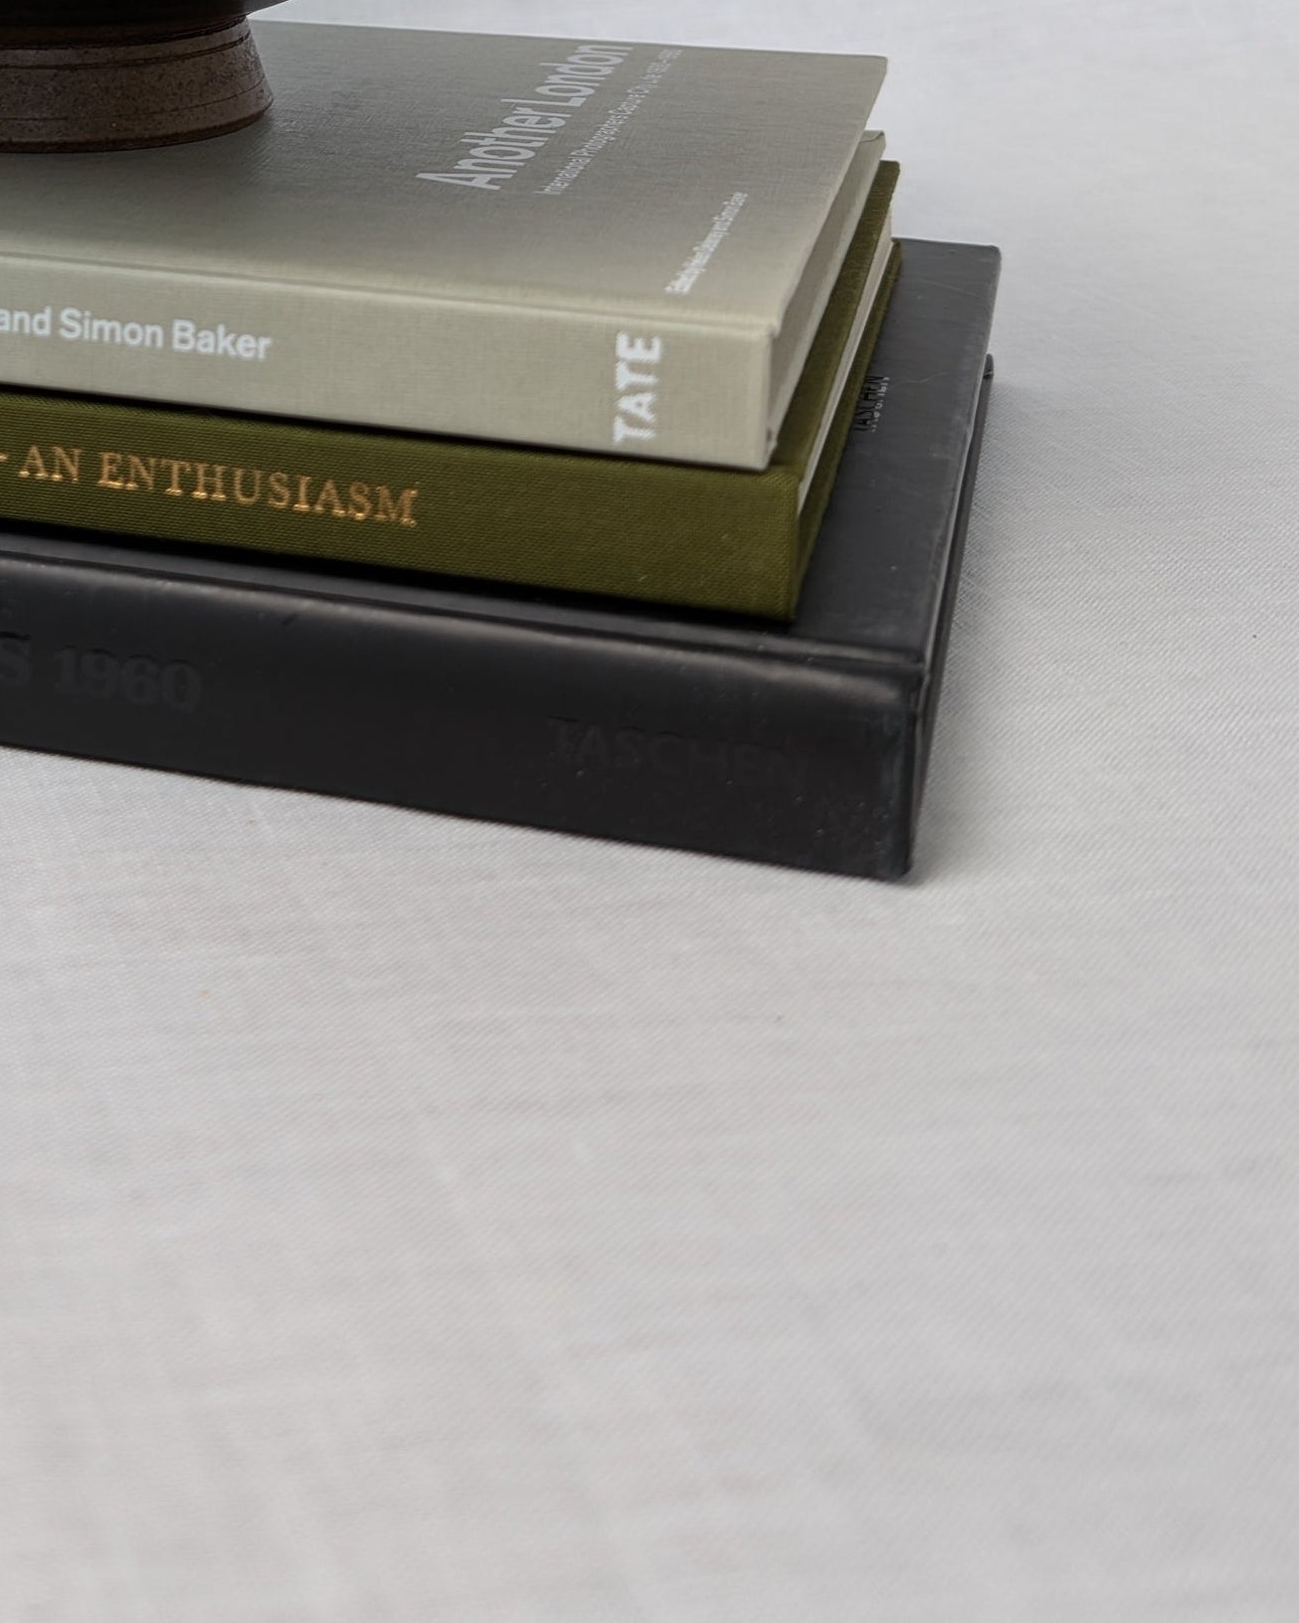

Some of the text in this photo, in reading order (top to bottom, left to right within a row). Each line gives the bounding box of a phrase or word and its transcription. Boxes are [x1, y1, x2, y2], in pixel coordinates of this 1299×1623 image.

[416, 107, 572, 191] Another
[501, 44, 634, 107] London
[60, 307, 164, 349] Simon
[173, 319, 272, 361] Baker
[613, 330, 662, 443] TATE
[18, 445, 82, 484] AN
[99, 451, 419, 529] ENTHUSIASM
[51, 644, 201, 712] 1960
